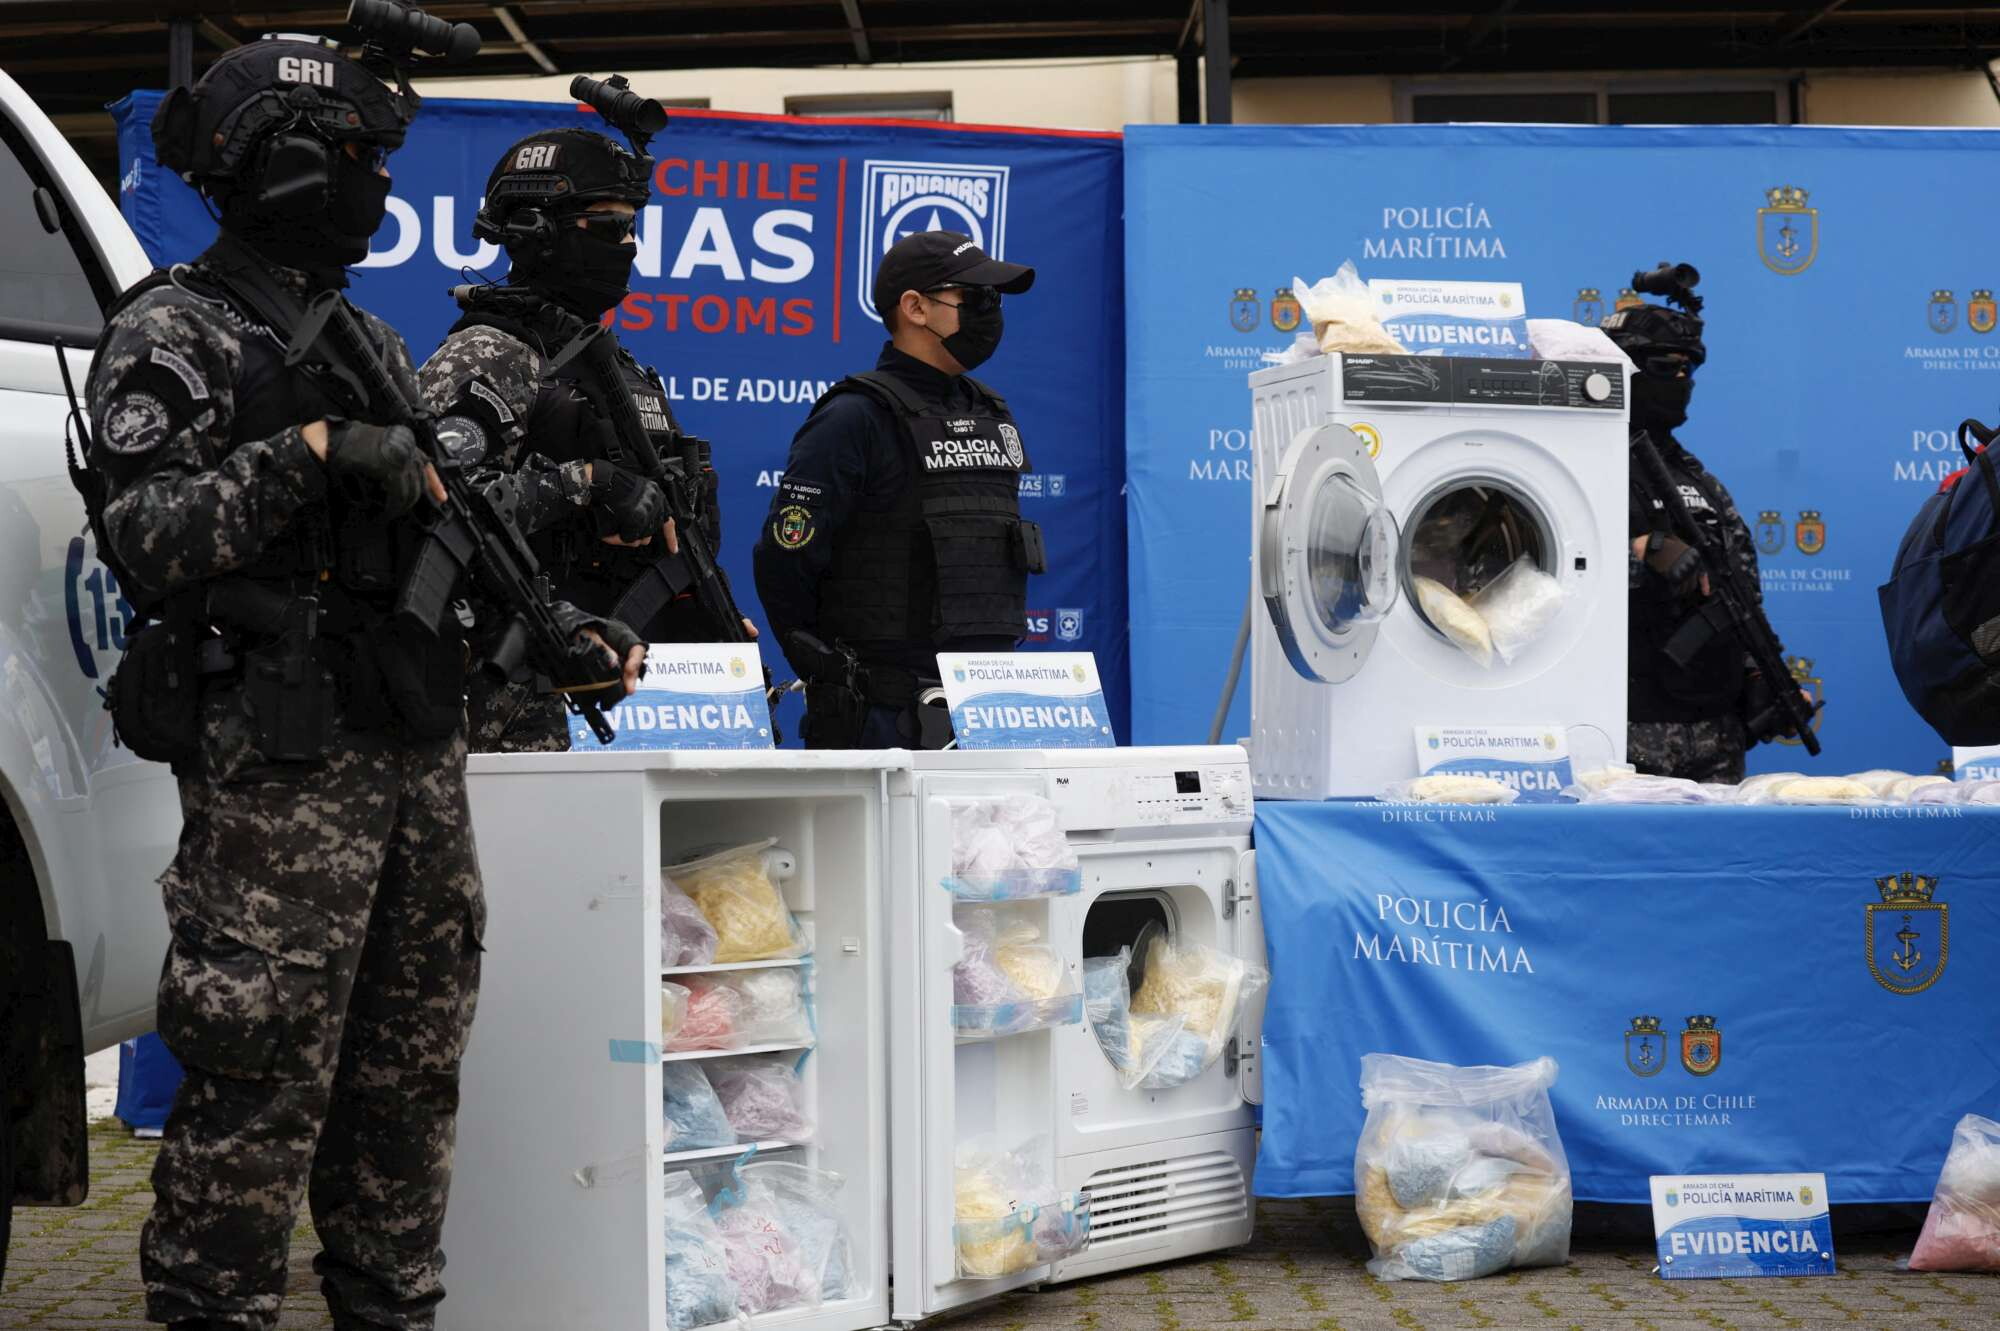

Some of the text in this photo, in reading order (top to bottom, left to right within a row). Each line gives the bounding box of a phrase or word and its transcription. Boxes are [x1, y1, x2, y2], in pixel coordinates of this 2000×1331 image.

[278, 56, 334, 88] GRI
[515, 145, 557, 170] GRI
[655, 158, 819, 202] CHILE
[881, 174, 990, 219] ADUANAS
[1383, 202, 1492, 229] POLICÍA
[1363, 232, 1507, 259] MARÍTIMA
[1397, 294, 1495, 305] POLICÍA MARÍTIMA
[601, 292, 814, 336] STOMS
[1386, 323, 1517, 345] EVIDENCIA
[1904, 347, 1959, 358] ARMADA
[1964, 347, 1979, 358] DE
[693, 377, 729, 401] DE
[931, 439, 1000, 454] POLICIA
[925, 452, 1012, 469] MARITIMA
[793, 485, 821, 495] ALERGICO
[1791, 569, 1808, 580] DE
[1811, 567, 1852, 581] CHILE
[656, 659, 726, 675] MARÍTIMA
[970, 667, 1070, 680] POLICÍA MARÍTIMA
[598, 704, 755, 731] VIDENCIA
[963, 706, 1098, 729] EVIDENCIA
[1443, 736, 1540, 748] POLICÍA MARÍTIMA
[1382, 809, 1497, 823] DIRECTEMAR
[1850, 807, 1963, 820] DIRECTEMAR
[1377, 894, 1513, 933] POLICÍA
[1353, 931, 1536, 974] MARÍTIMA
[1596, 1094, 1757, 1110] ARMADA DE CHILE
[1621, 1113, 1732, 1126] DIRECTEMAR
[1683, 1188, 1795, 1204] POLICÍA MARÍTIMA
[1671, 1230, 1819, 1256] EVIDENCIA
